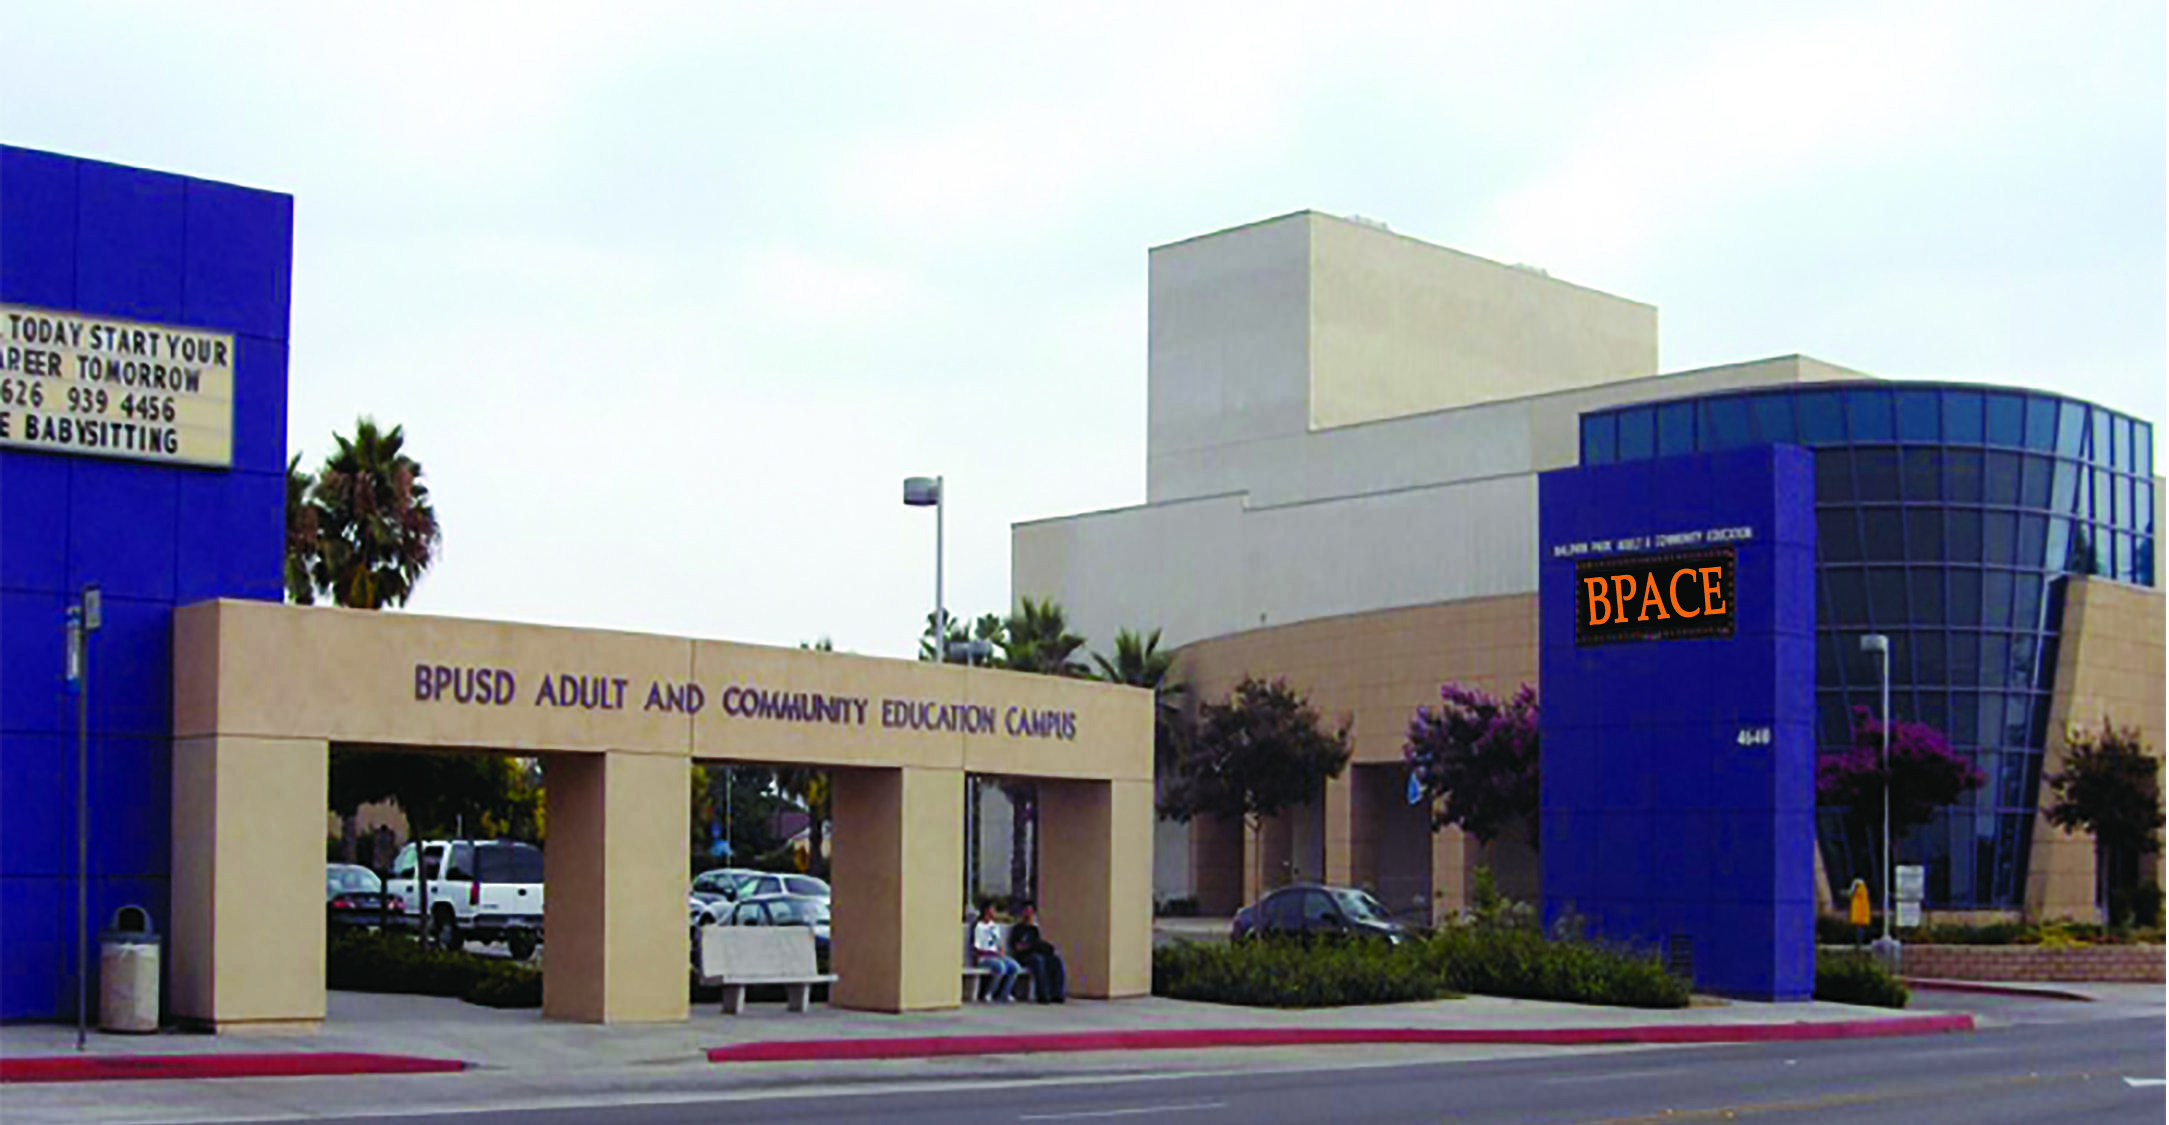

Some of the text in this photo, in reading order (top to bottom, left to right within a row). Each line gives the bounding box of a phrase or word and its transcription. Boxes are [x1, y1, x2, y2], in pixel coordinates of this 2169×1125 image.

[9, 314, 227, 366] TODAY START YOUR
[0, 346, 201, 392] REER TOMORROW
[1, 378, 175, 422] 626 939 4456
[25, 414, 178, 454] BABYSITTING
[1584, 566, 1727, 626] BPACE
[414, 664, 1077, 741] BPUSD ADULT AND COMMUNITY EDUCATION CAMPUS
